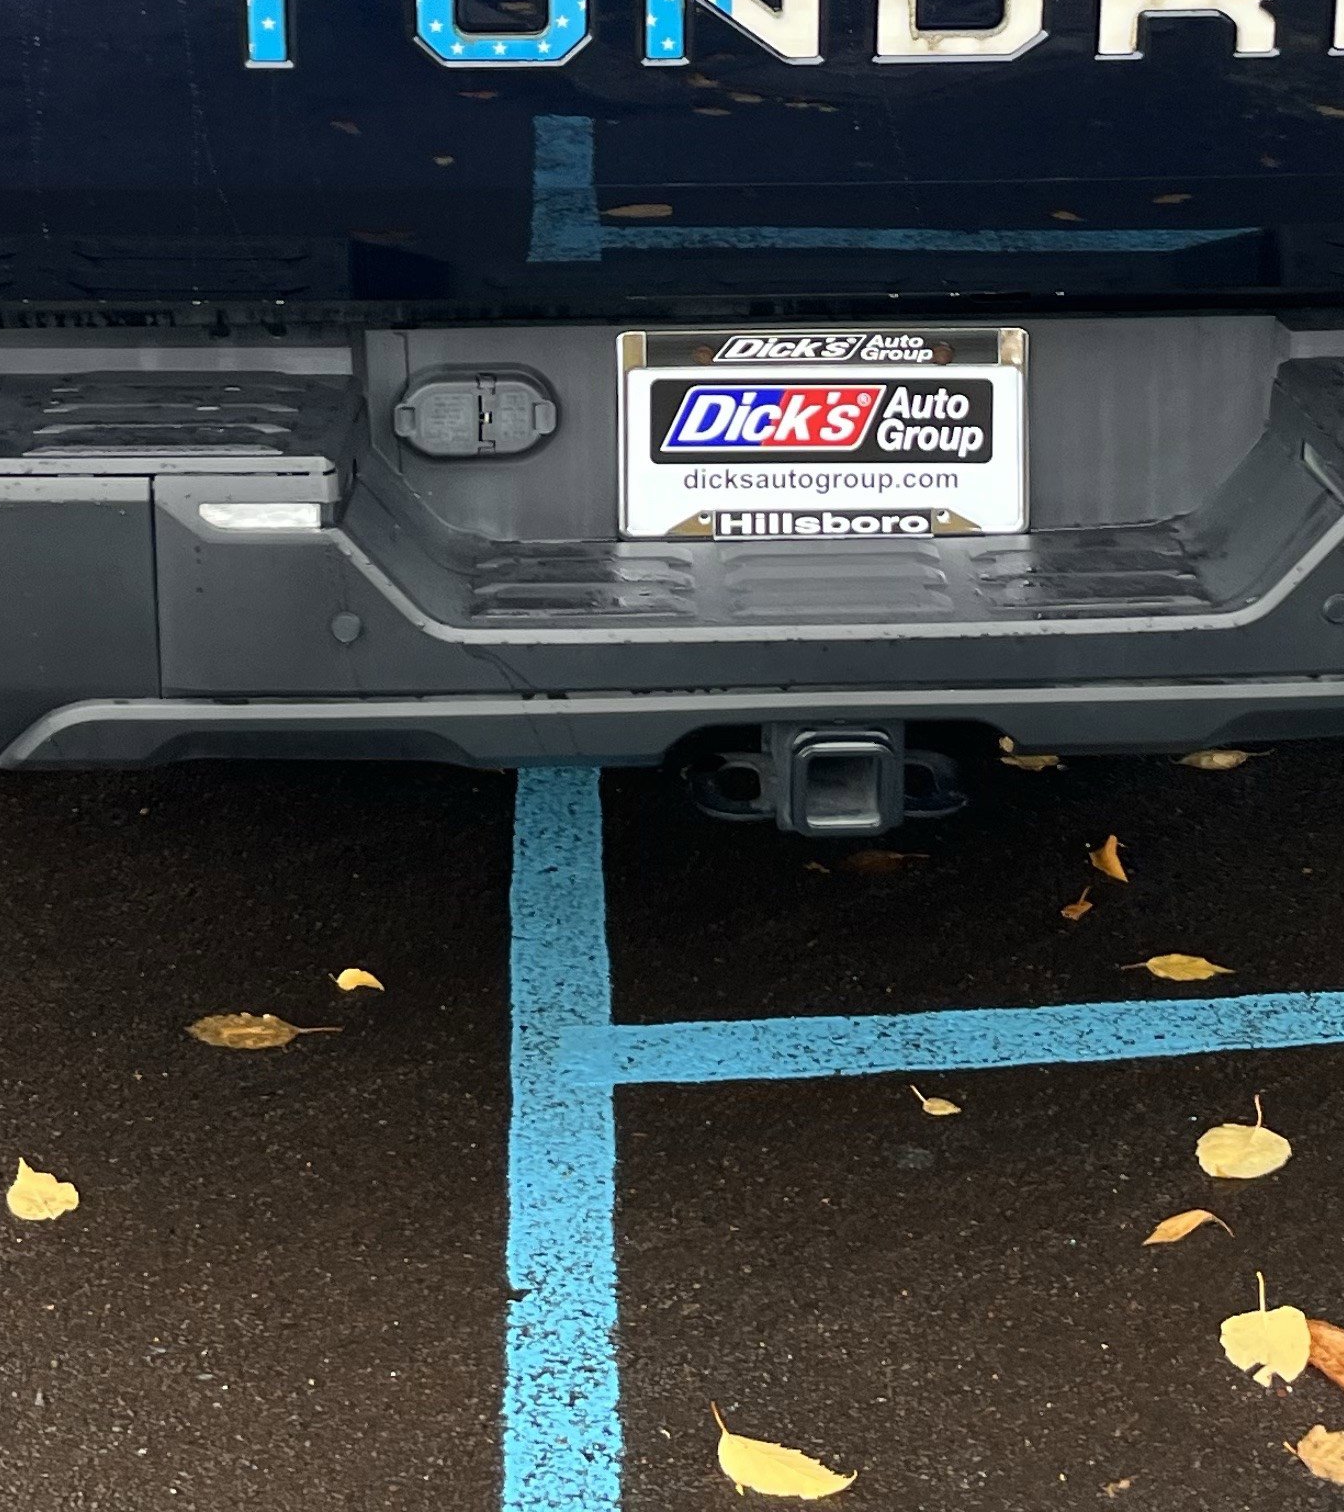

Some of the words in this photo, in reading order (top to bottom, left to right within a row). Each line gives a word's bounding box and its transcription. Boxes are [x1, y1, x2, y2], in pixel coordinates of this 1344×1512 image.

[866, 334, 924, 349] Auto
[860, 347, 934, 363] Group
[883, 387, 970, 420] Auto
[876, 418, 985, 457] Group
[683, 469, 959, 494] dicksautogroup.com
[719, 512, 930, 536] Hillsboro
